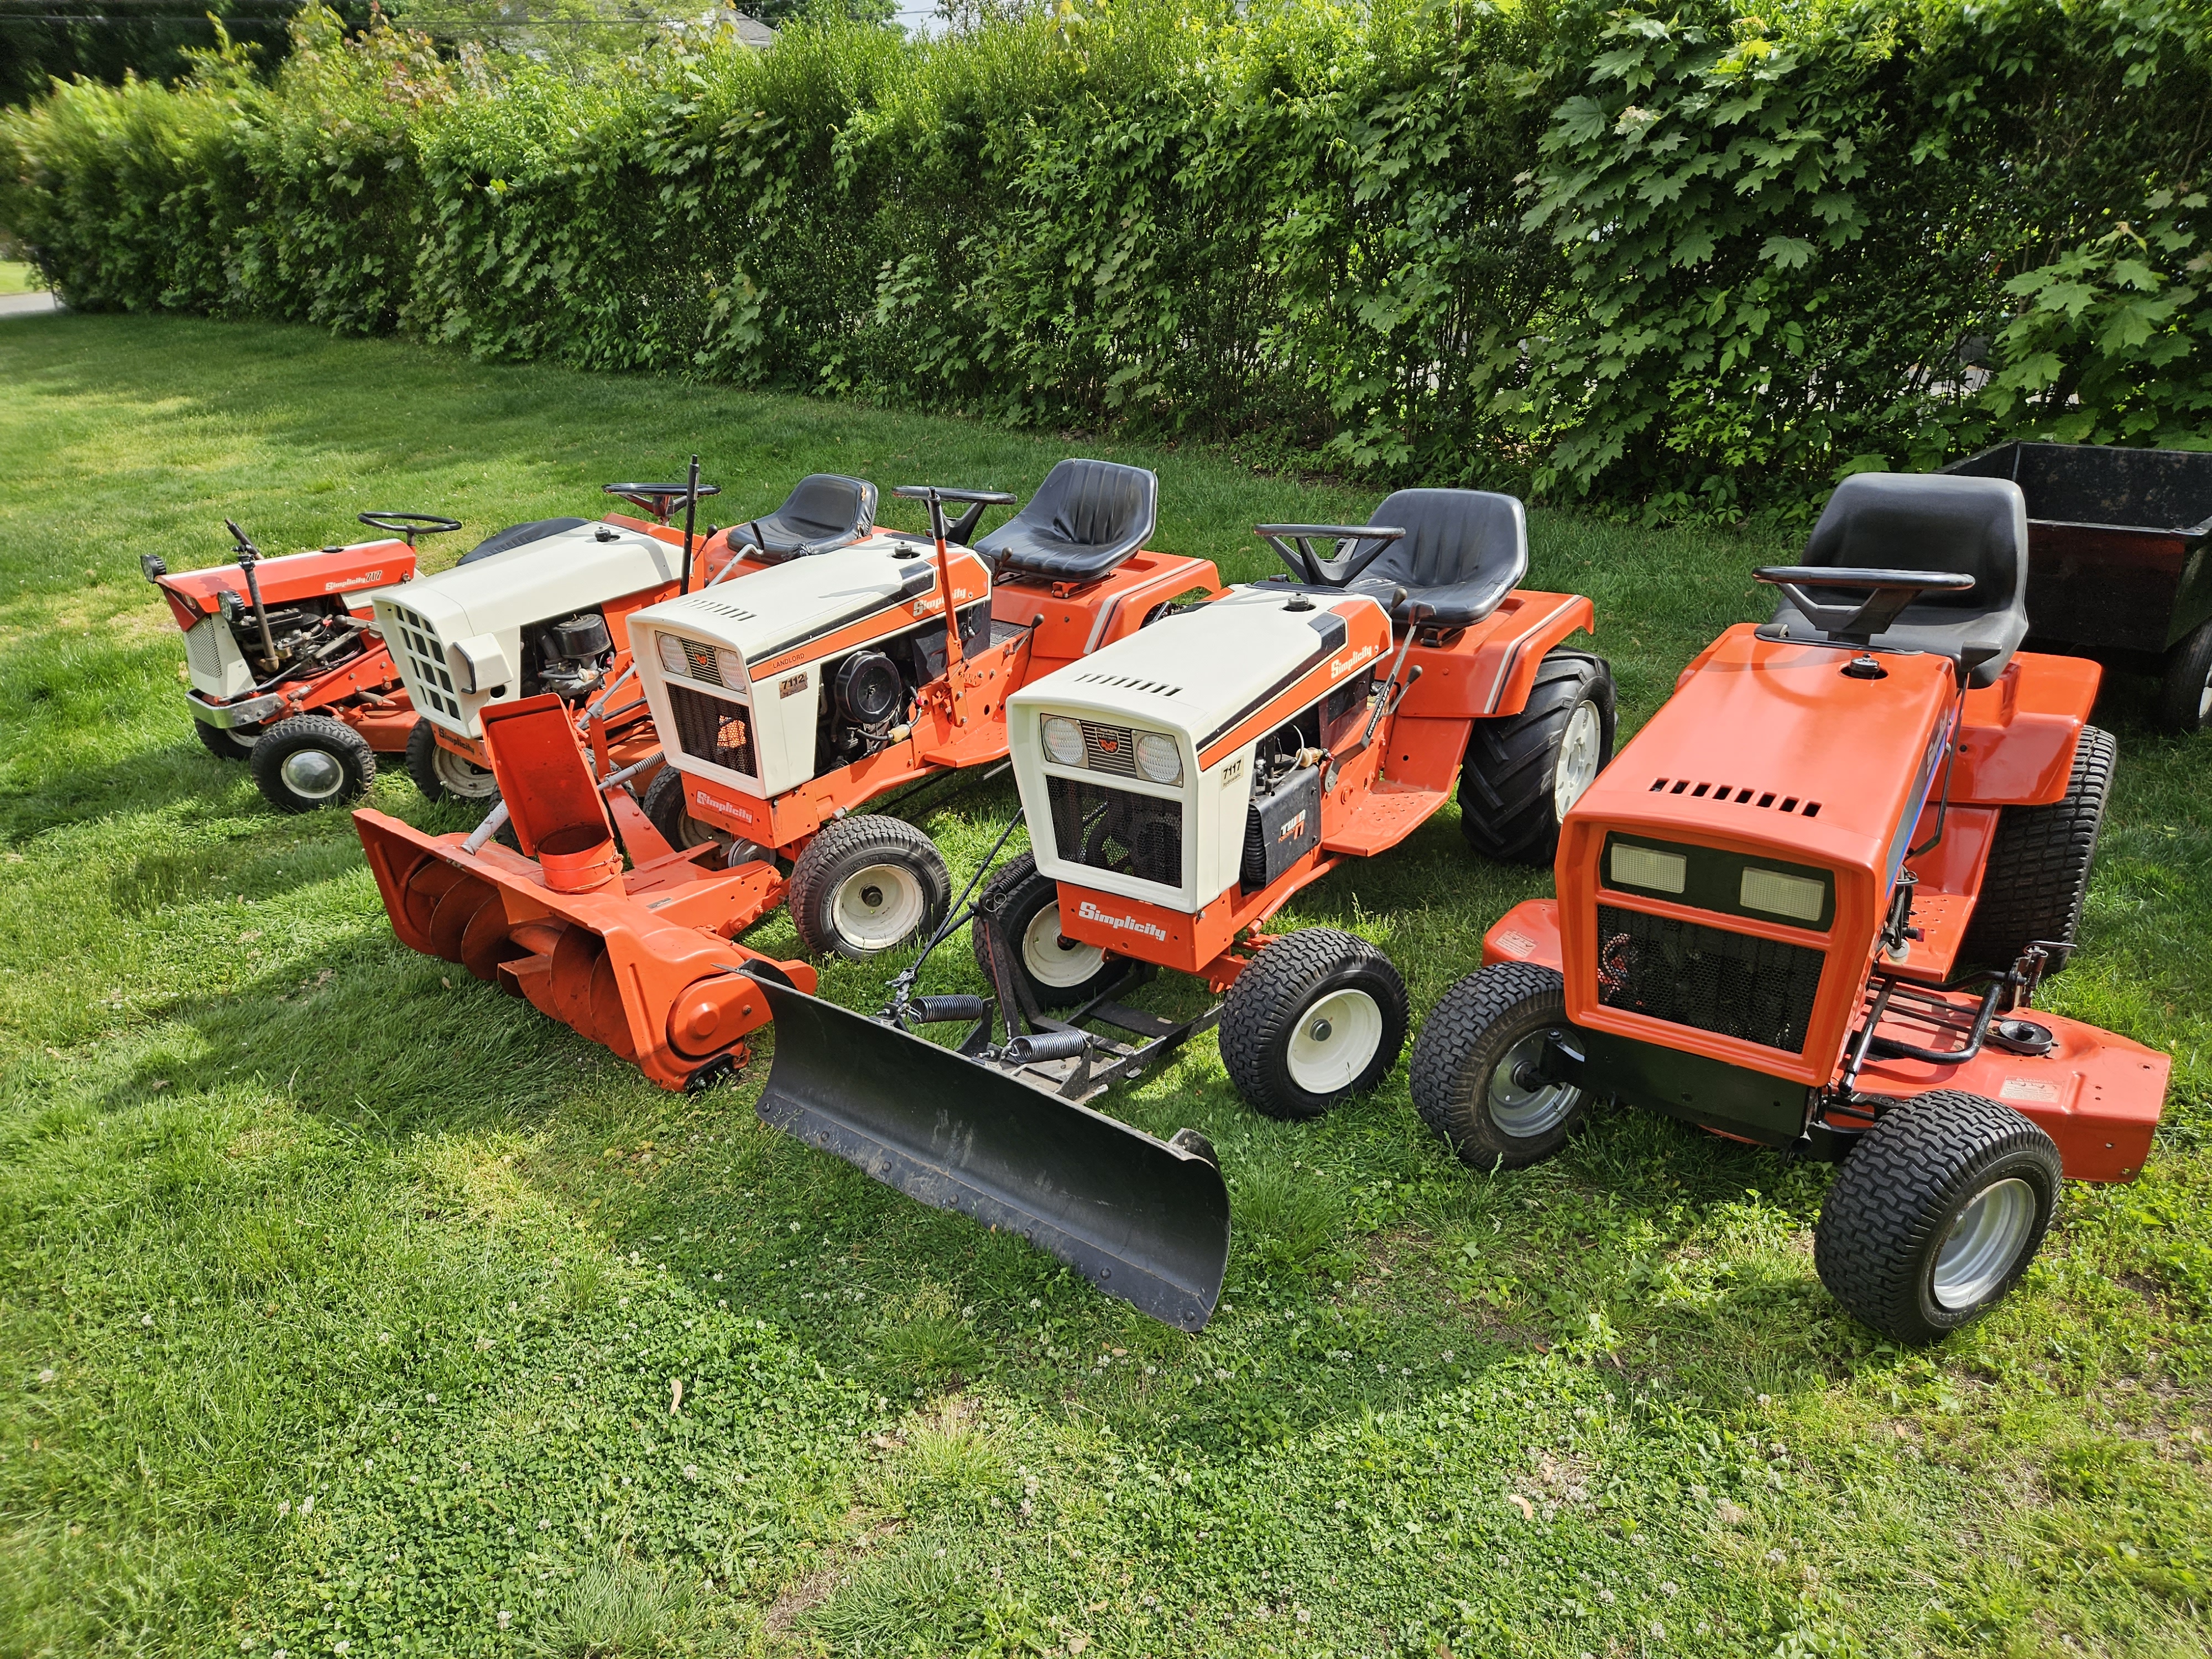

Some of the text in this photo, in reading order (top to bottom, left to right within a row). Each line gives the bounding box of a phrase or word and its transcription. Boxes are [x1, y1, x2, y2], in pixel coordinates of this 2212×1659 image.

[325, 570, 382, 591] Simplicity 717
[913, 588, 967, 617] Simplity
[773, 653, 805, 669] LANDLORD
[1331, 645, 1372, 680] Simplicity
[781, 674, 805, 690] 7112
[439, 727, 475, 755] Simplicity
[1223, 759, 1241, 780] 7117
[697, 790, 752, 824] Simplicity
[1078, 901, 1166, 942] Simplicity
